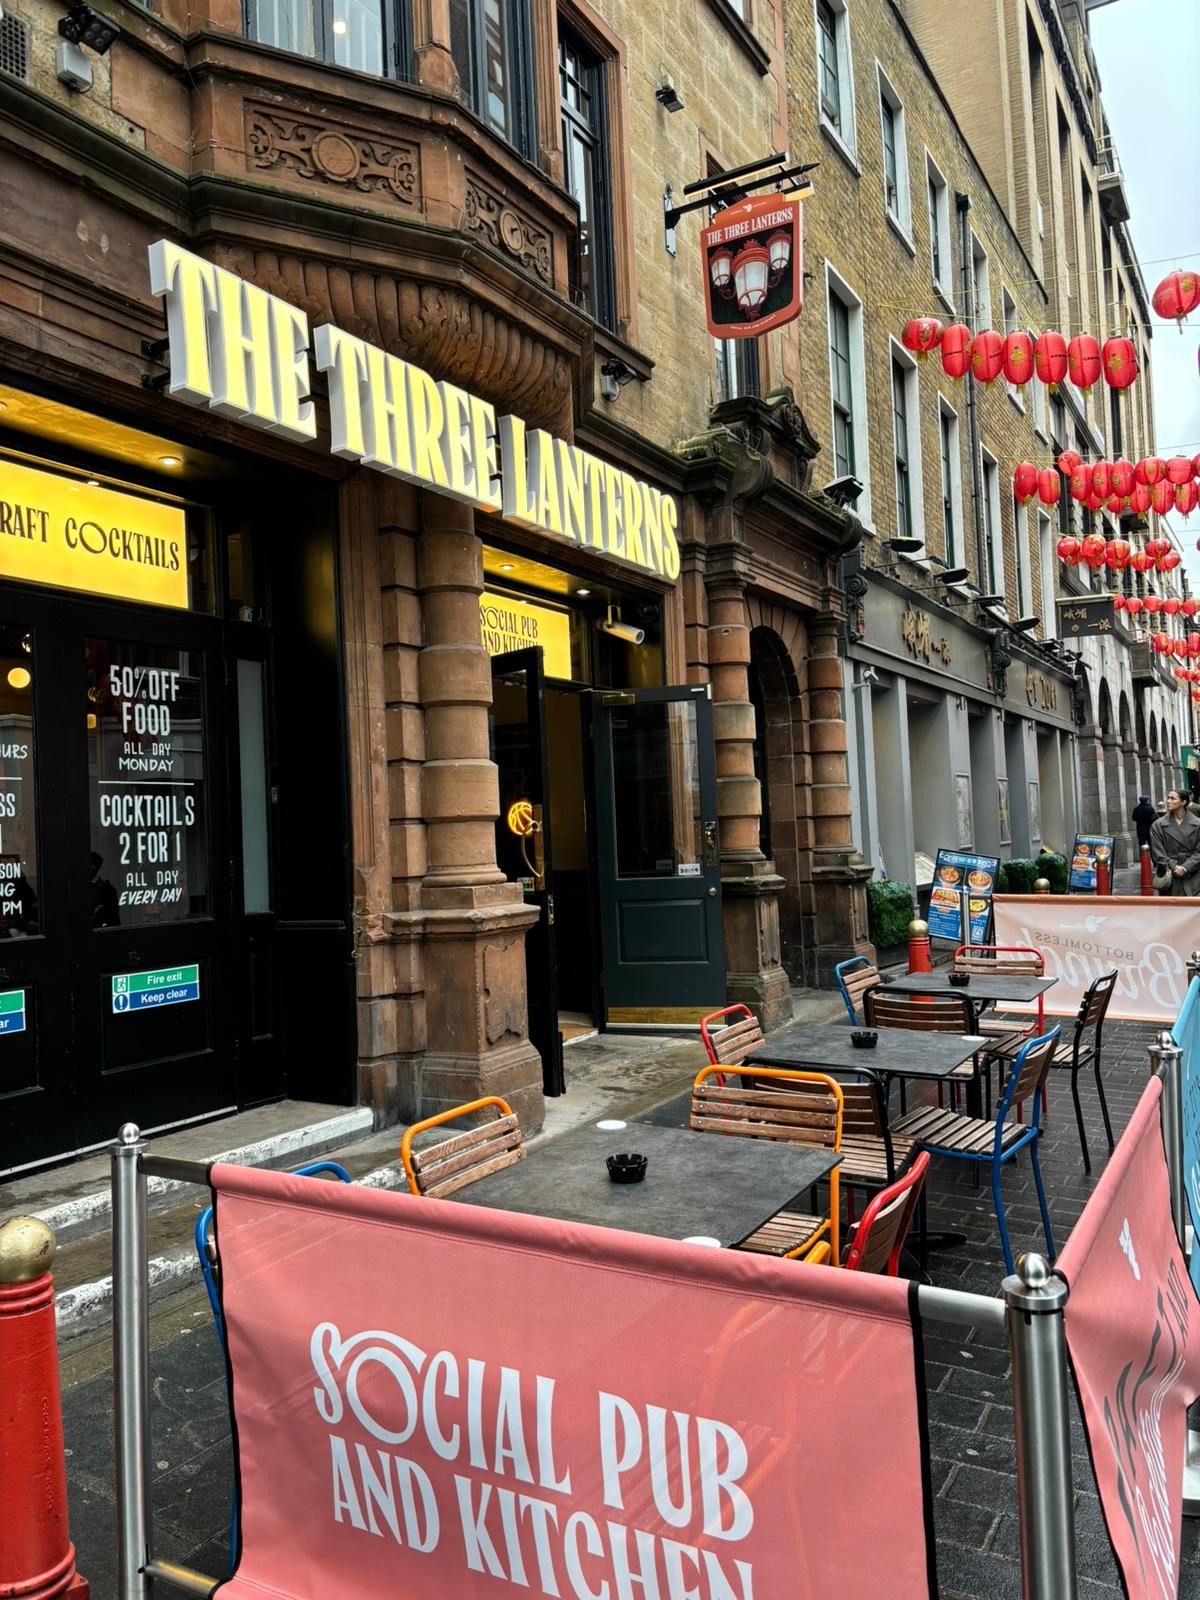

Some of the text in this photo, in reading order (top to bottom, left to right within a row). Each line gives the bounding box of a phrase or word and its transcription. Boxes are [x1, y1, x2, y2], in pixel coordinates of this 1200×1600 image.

[706, 231, 722, 245] THE
[724, 220, 750, 239] THREE
[751, 207, 793, 230] LANTERNS
[150, 240, 680, 580] THE THREE LANTERNS
[65, 516, 180, 571] COCKTAILS
[480, 605, 538, 639] SOCIAL PUB
[122, 702, 171, 736] FOOD
[119, 757, 174, 772] MONDAY
[124, 741, 172, 756] ALL DAY
[100, 794, 195, 827] COCKTAILS
[120, 831, 182, 865] 2 FOR 1
[126, 870, 179, 887] ALL DAY
[3, 900, 22, 916] PM
[118, 887, 182, 906] EVERY DAY
[147, 971, 183, 985] Fire exit
[140, 987, 188, 1005] Keep clear
[310, 1321, 754, 1542] SOCIAL PUB
[328, 1434, 440, 1554] AND
